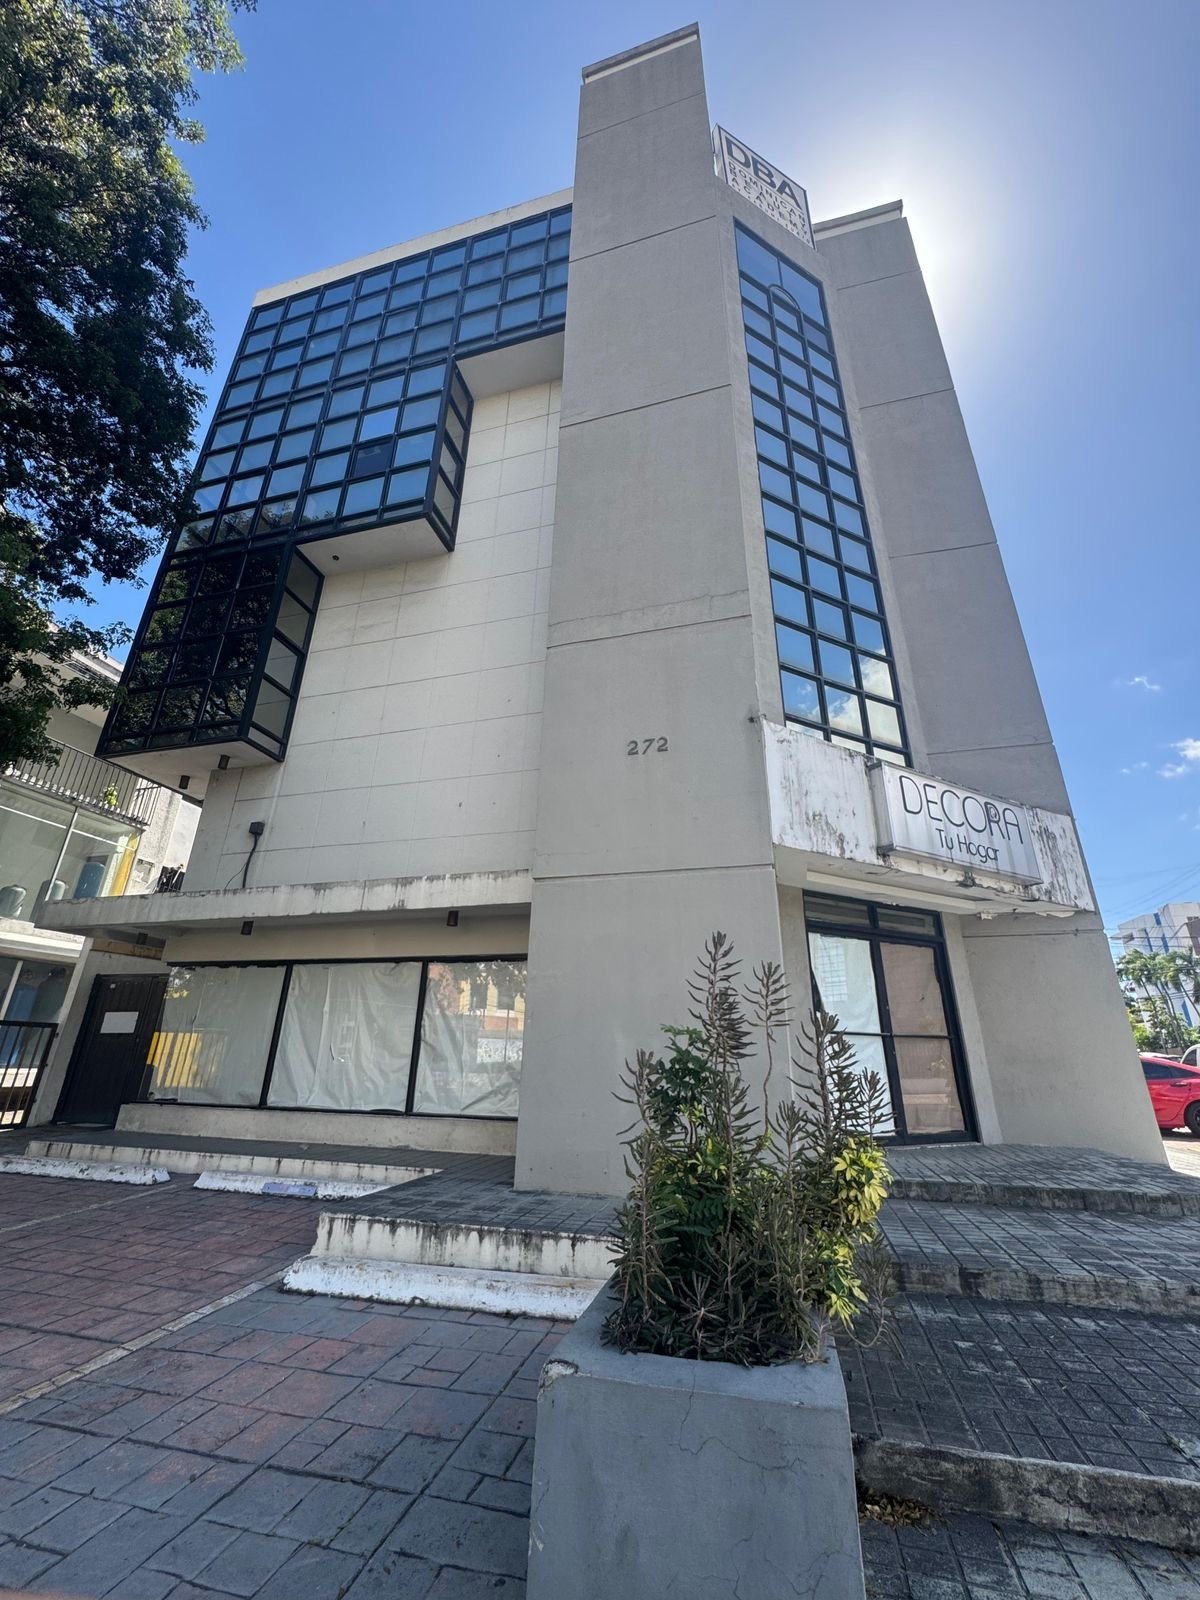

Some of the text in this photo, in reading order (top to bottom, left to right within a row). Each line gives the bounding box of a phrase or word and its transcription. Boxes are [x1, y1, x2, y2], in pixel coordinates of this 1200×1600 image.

[724, 135, 802, 211] DBA
[728, 161, 805, 222] DOMINICAN
[729, 167, 806, 229] BEAUTY
[731, 175, 808, 237] ACADEMY
[627, 737, 669, 755] 272
[899, 775, 1024, 845] DECORA
[935, 828, 1000, 864] Tu Hogar
